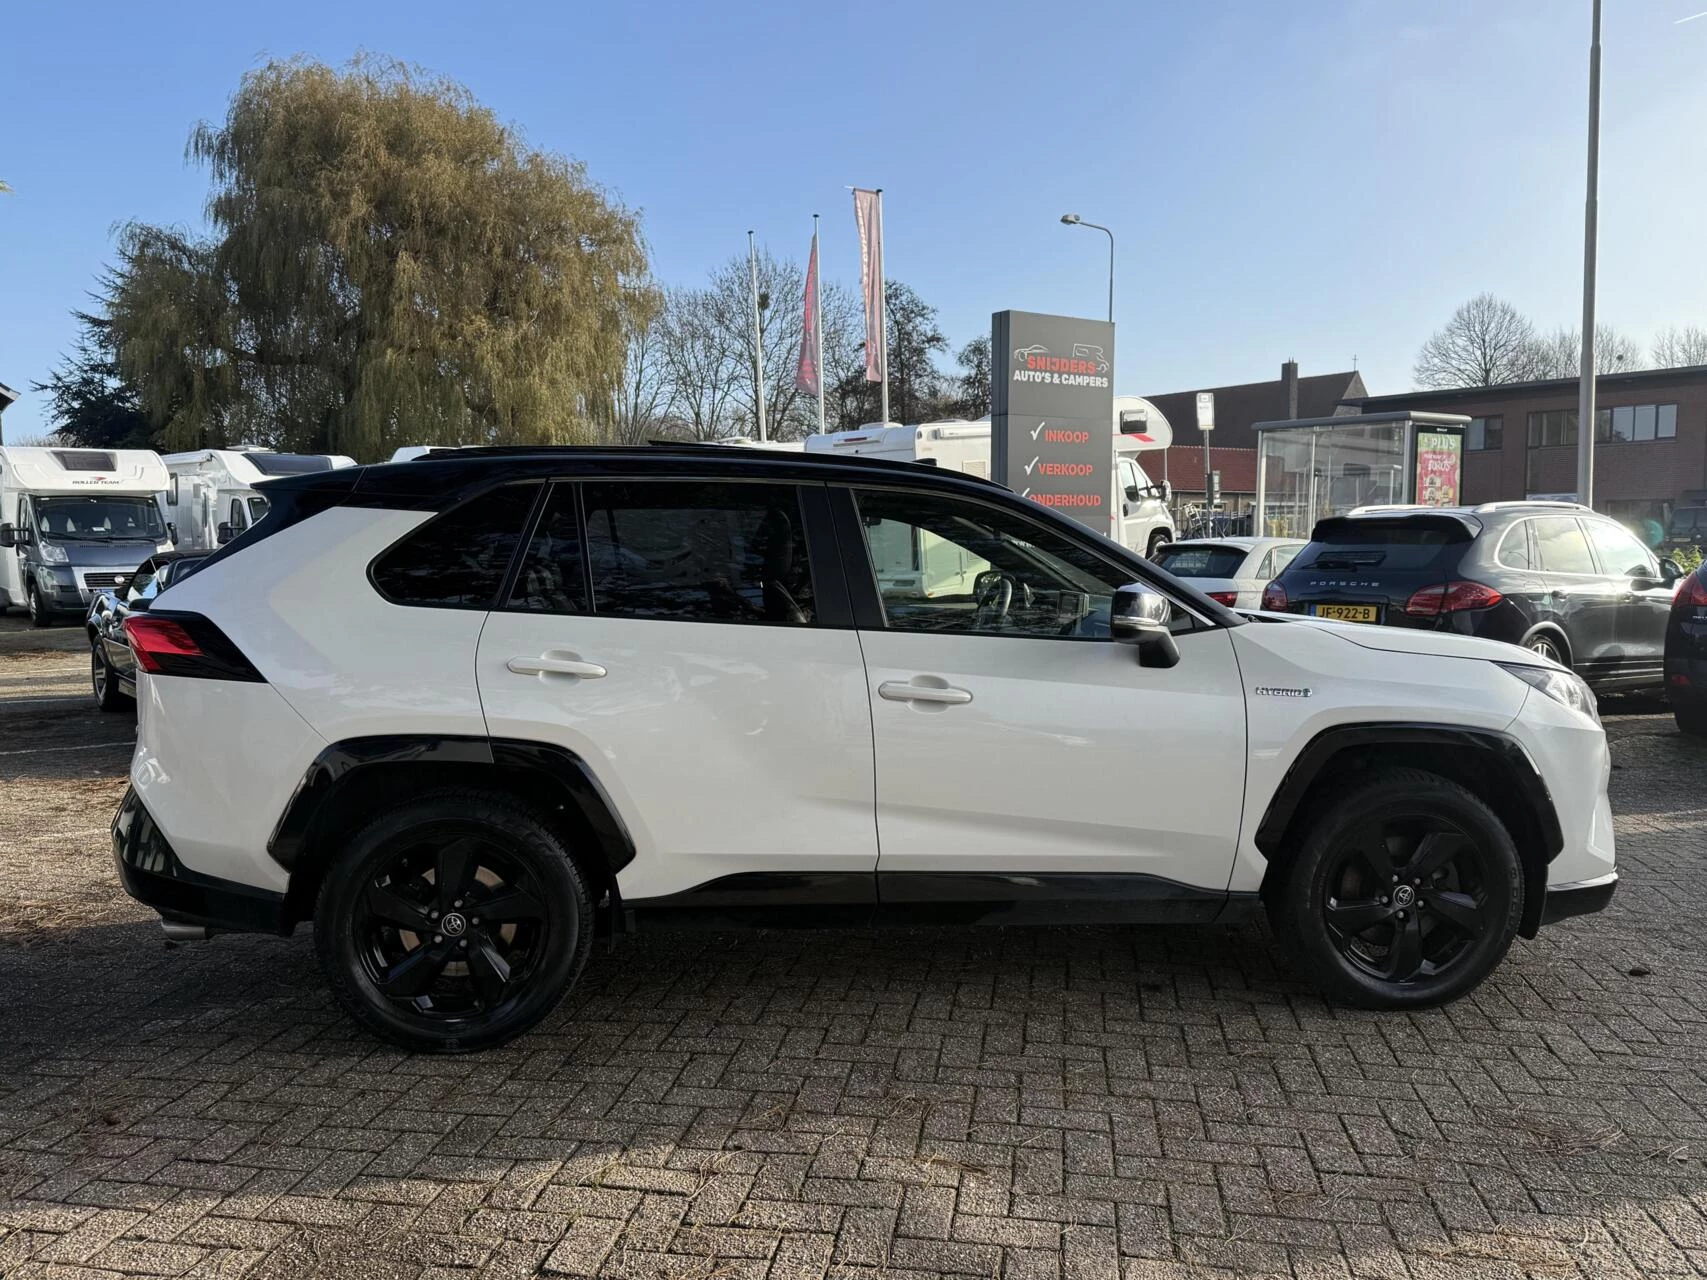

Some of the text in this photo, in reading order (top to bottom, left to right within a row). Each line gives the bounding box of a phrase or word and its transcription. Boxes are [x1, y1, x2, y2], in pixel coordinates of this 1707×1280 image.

[1027, 355, 1096, 374] SNIJDERS
[1013, 369, 1108, 388] AUTO'S & CAMPERS
[1045, 430, 1089, 443] INKOOP
[1038, 463, 1093, 476] VERKOOP
[1028, 493, 1102, 507] ONDERHOUD
[1319, 606, 1370, 619] JF-922-B
